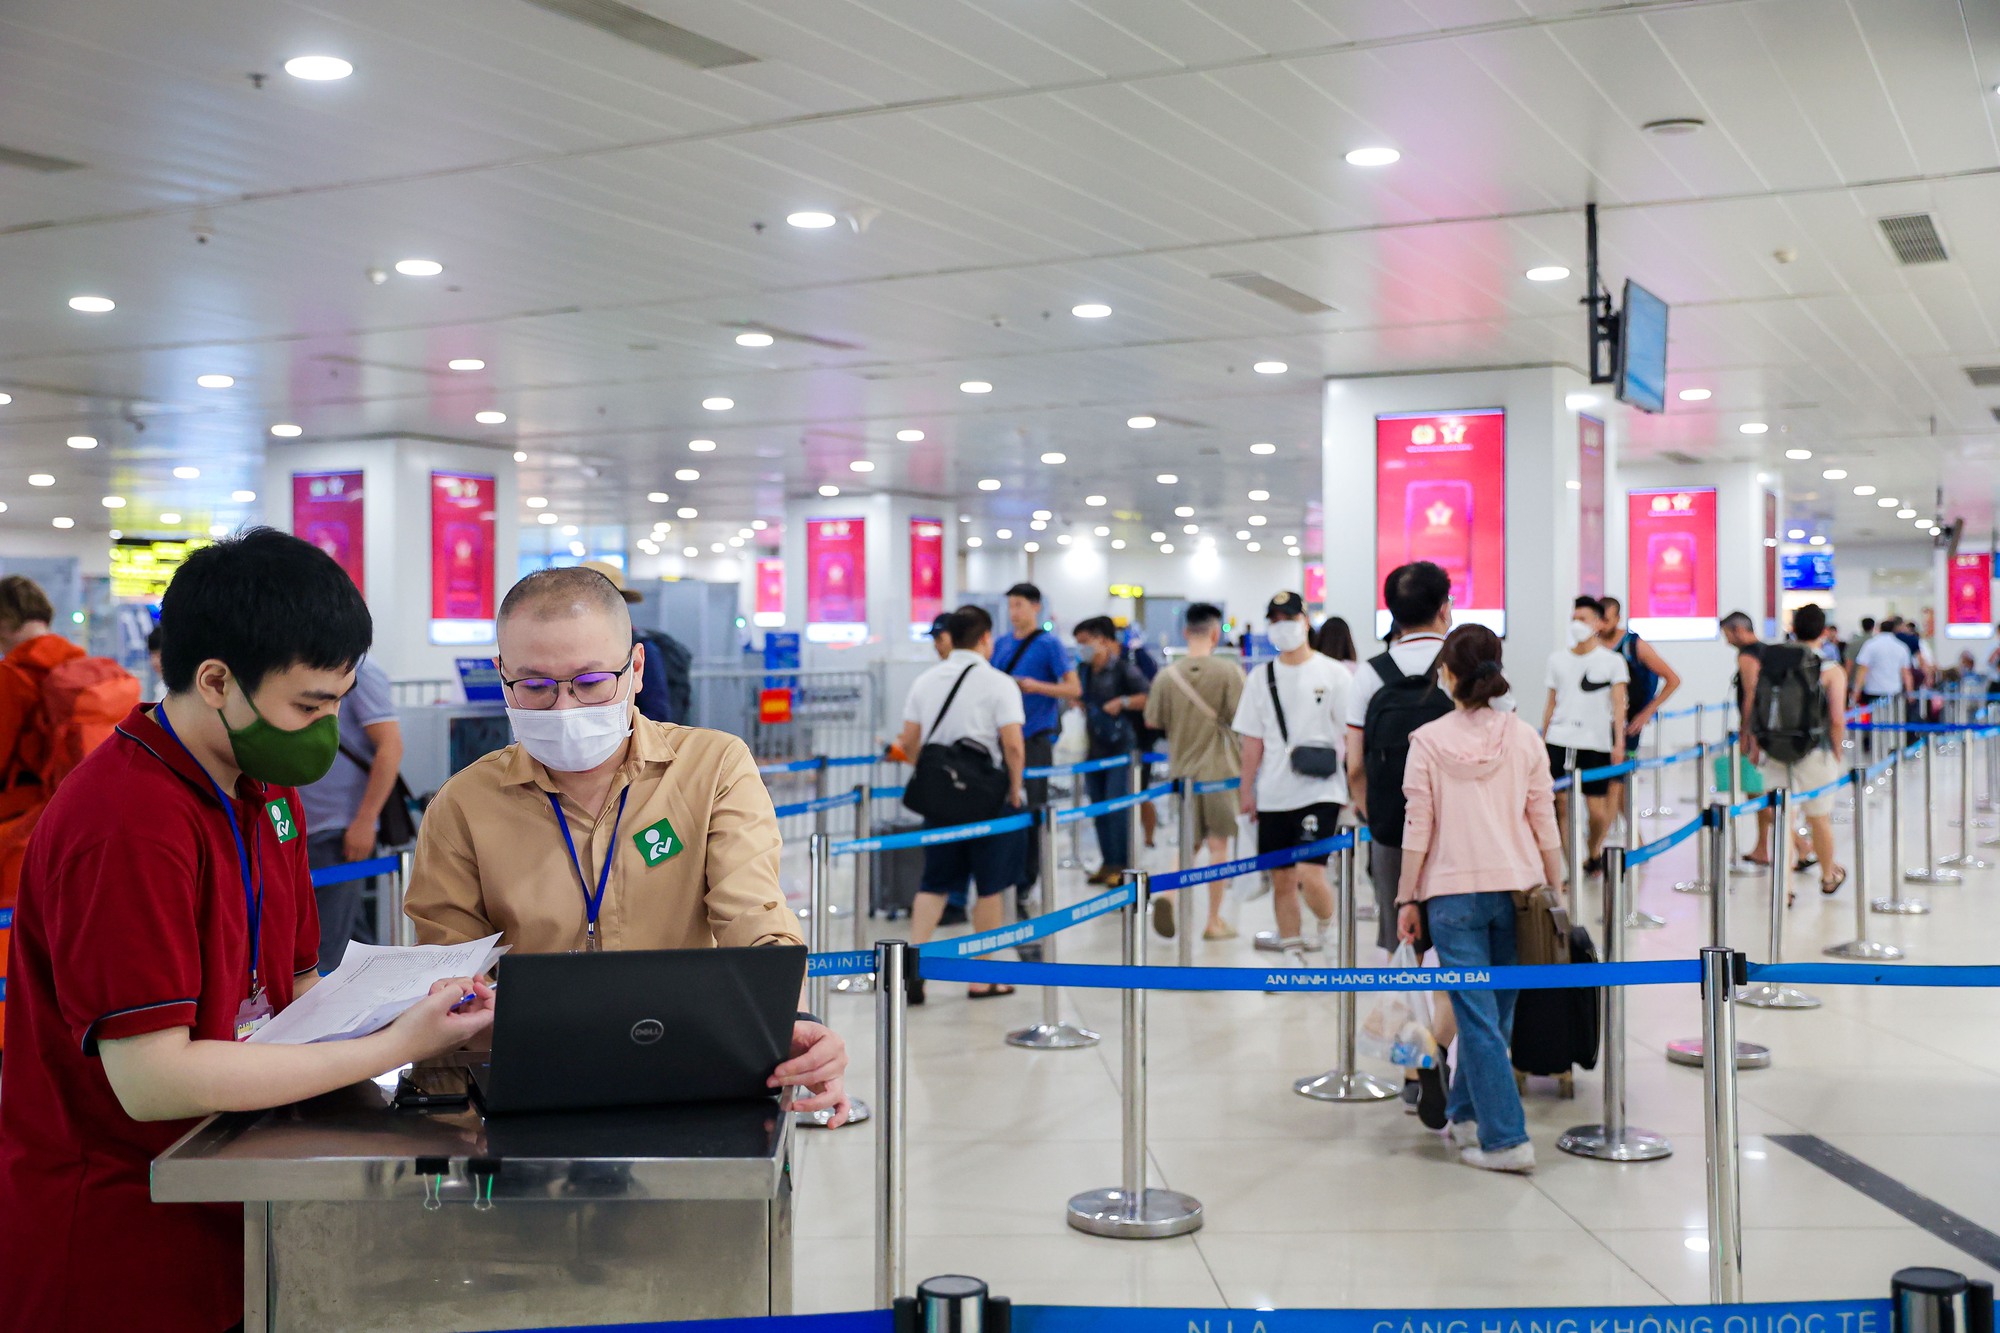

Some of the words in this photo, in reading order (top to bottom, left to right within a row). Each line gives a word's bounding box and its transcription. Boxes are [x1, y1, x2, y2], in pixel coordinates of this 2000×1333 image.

[837, 954, 879, 968] INTE
[1265, 973, 1288, 985] AN
[1291, 973, 1327, 985] NINH
[1378, 971, 1432, 984] KHÔNG
[1464, 969, 1491, 983] BÀI
